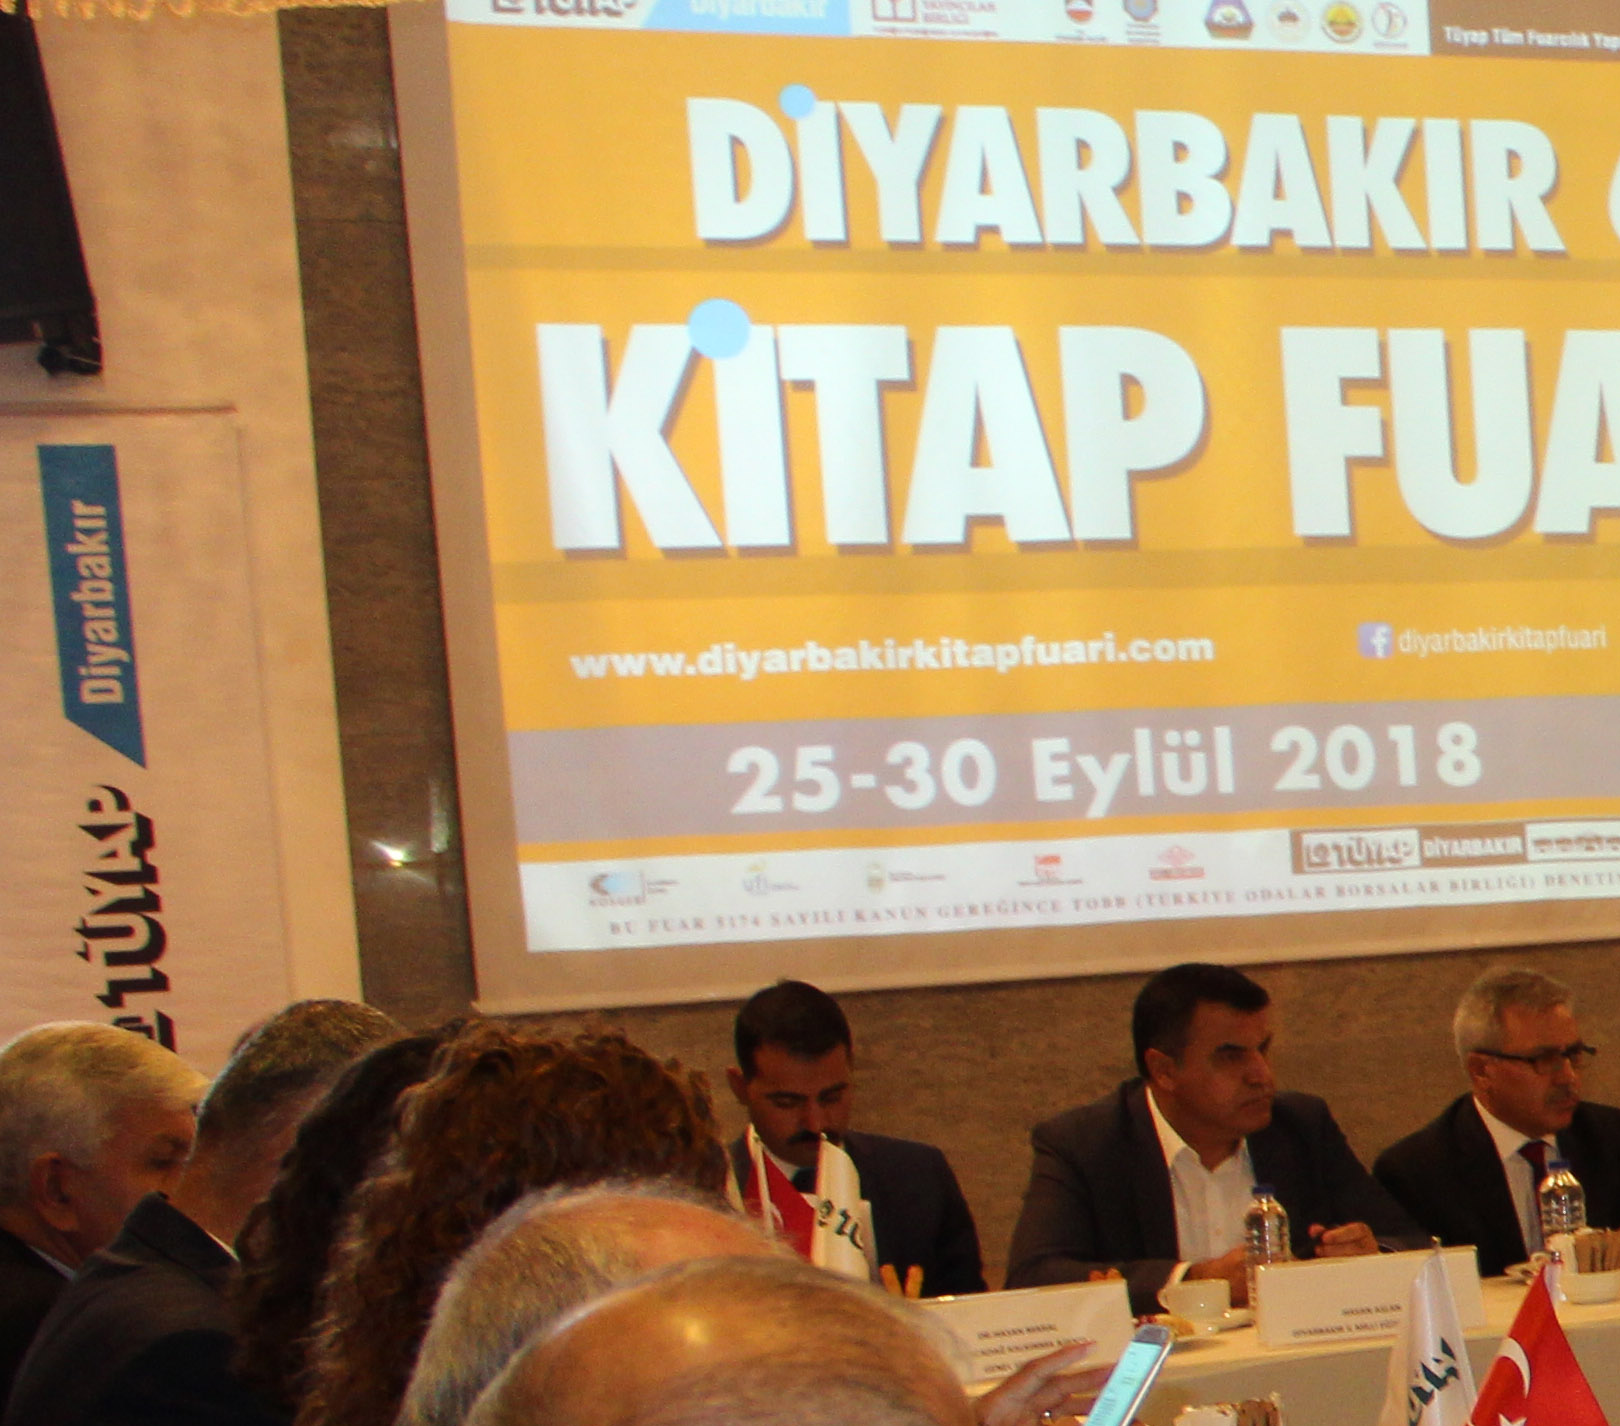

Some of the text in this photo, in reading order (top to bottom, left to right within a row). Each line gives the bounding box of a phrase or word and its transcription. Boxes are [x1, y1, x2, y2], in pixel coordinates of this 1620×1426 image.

[686, 84, 1568, 252] DİYARBAKIR
[536, 298, 1204, 550] KİTAP
[66, 498, 125, 706] Diyarbakır
[570, 633, 1215, 680] www.diyarbakirkitapfuari.com
[1399, 625, 1607, 657] diyarbakirkitapfuari
[727, 722, 1484, 819] 25-30 Eylül 2018
[75, 783, 170, 1009] TÜYAP
